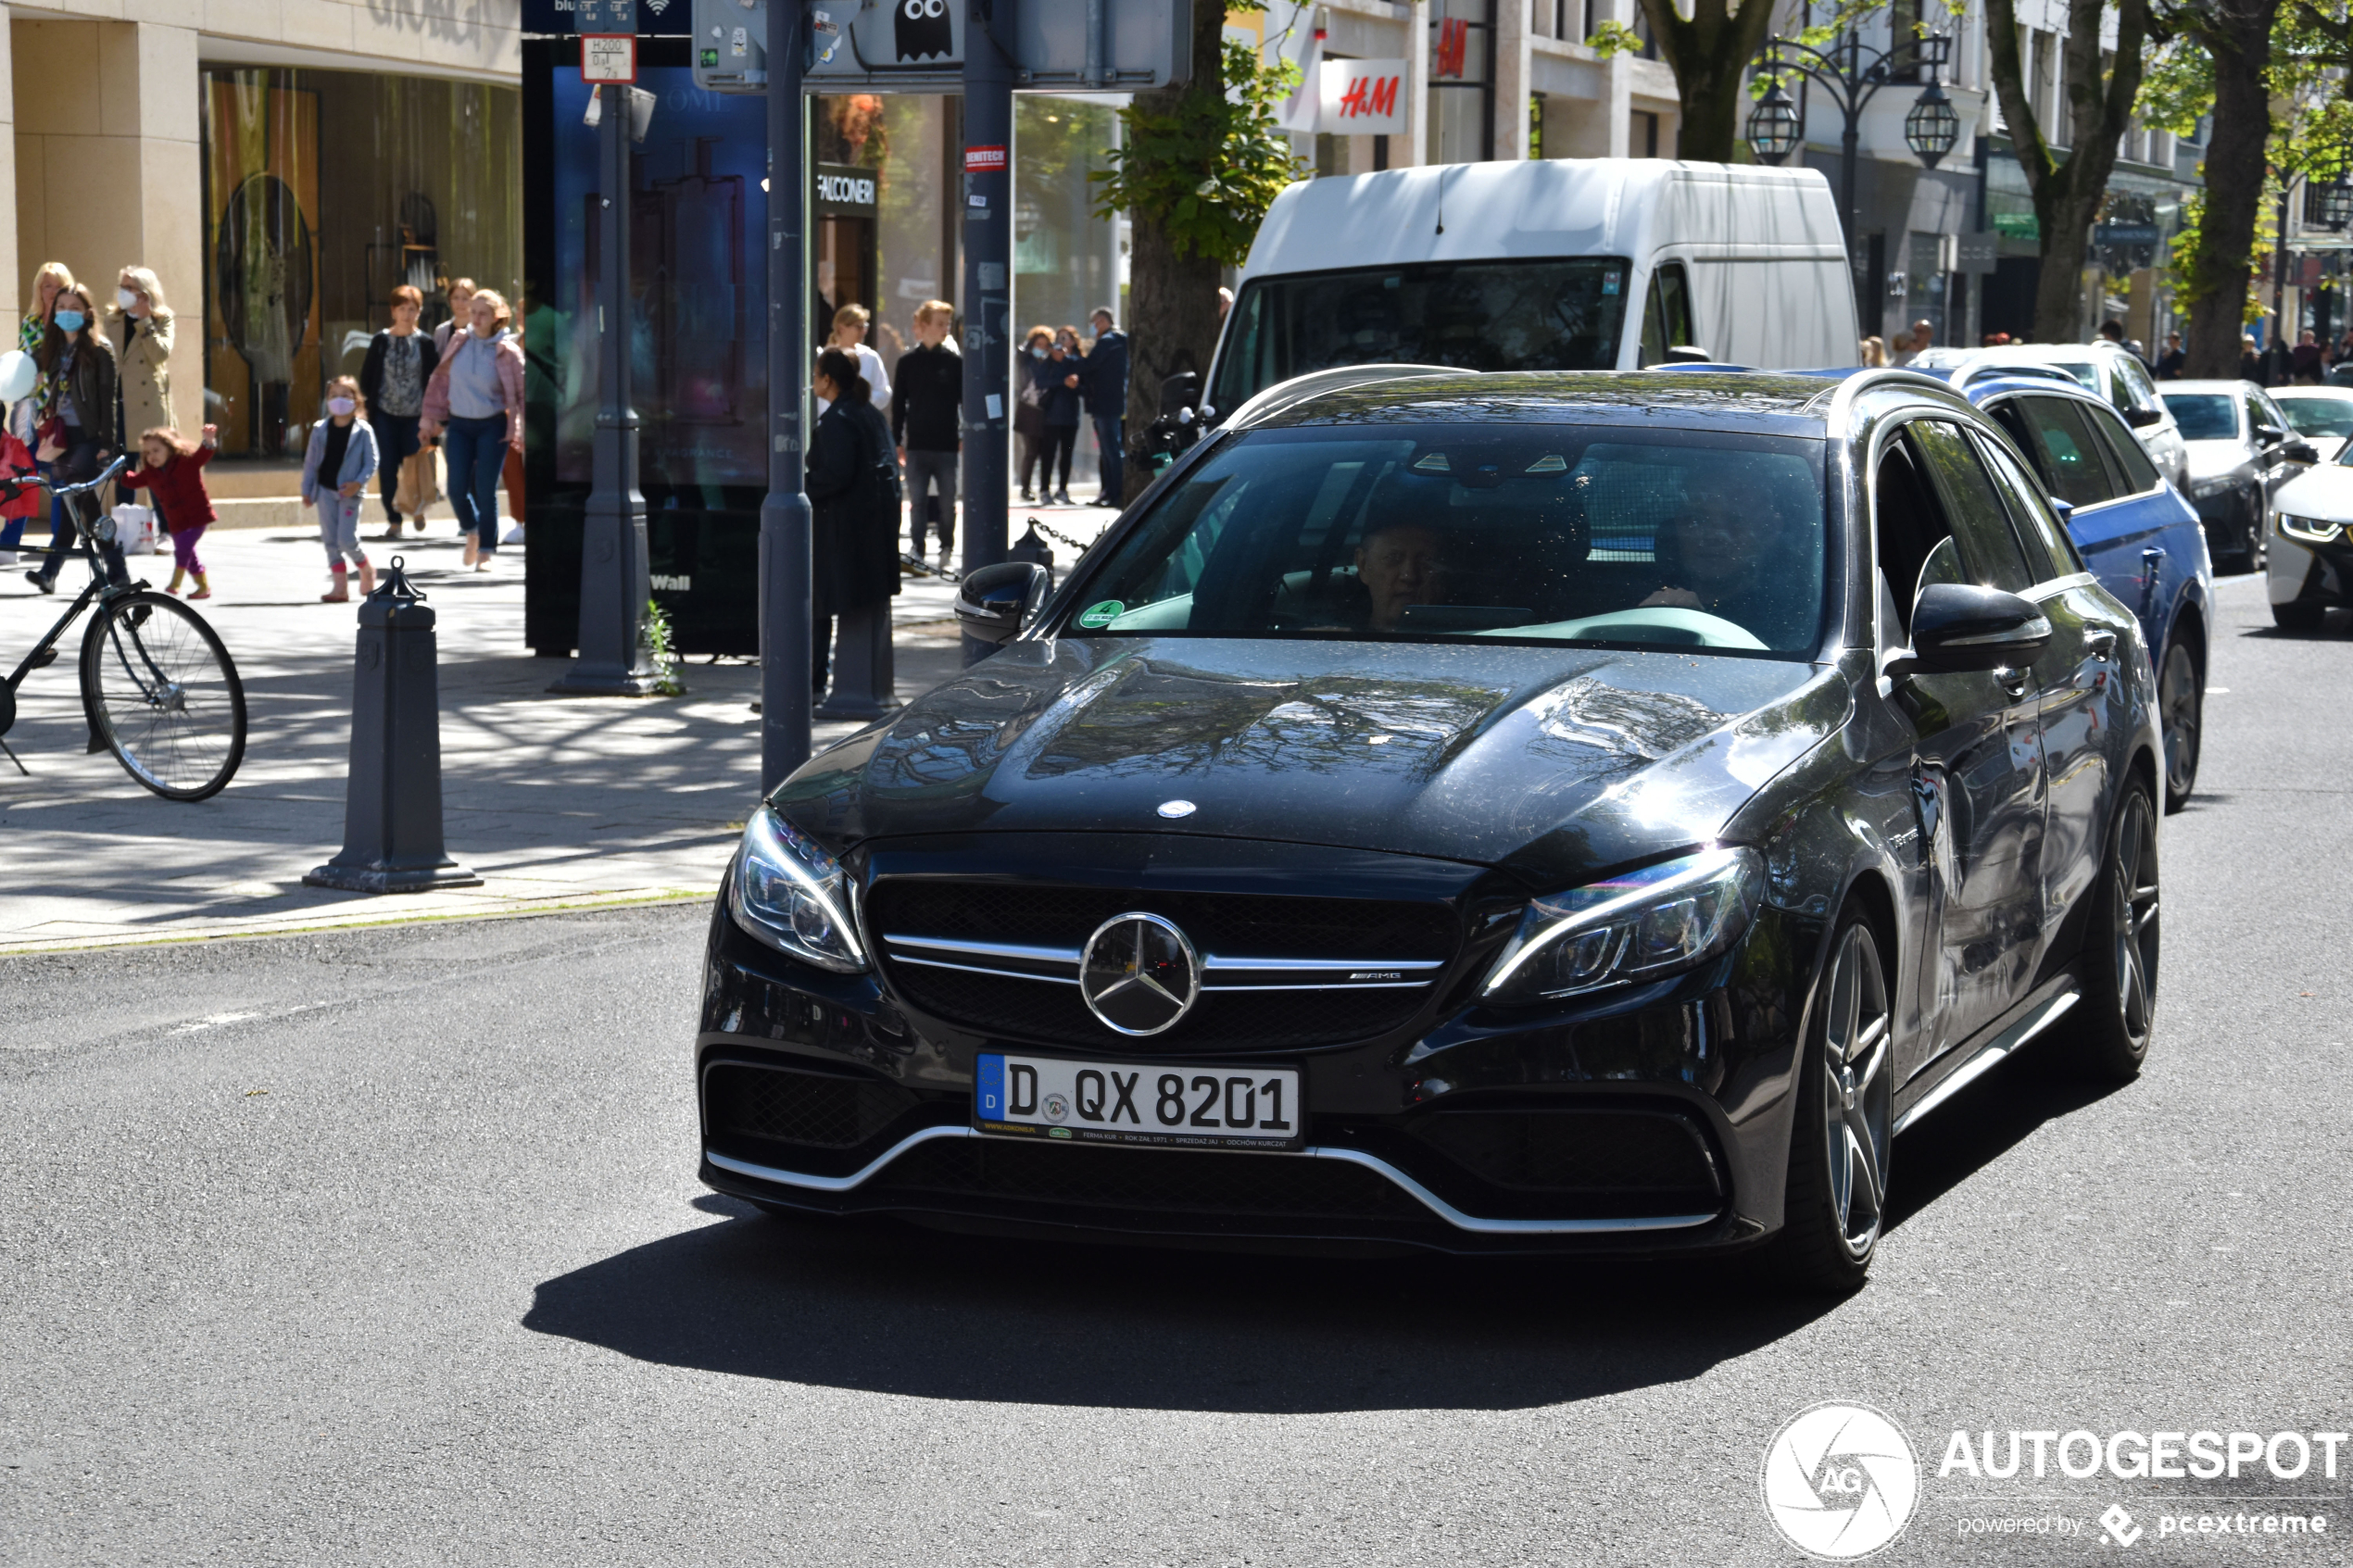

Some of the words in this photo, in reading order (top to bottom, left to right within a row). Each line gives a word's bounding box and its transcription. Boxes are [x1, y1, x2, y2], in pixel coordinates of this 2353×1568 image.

[1340, 76, 1399, 118] H&M
[649, 574, 690, 591] Wall
[1099, 602, 1114, 614] 4
[986, 1095, 996, 1109] D
[1010, 1064, 1038, 1115] D
[1076, 1069, 1140, 1123] QX
[1156, 1073, 1290, 1130] 8201
[985, 1123, 1036, 1134] WWW.ADKONIS.PL
[1227, 1138, 1256, 1147] ODCHÓW
